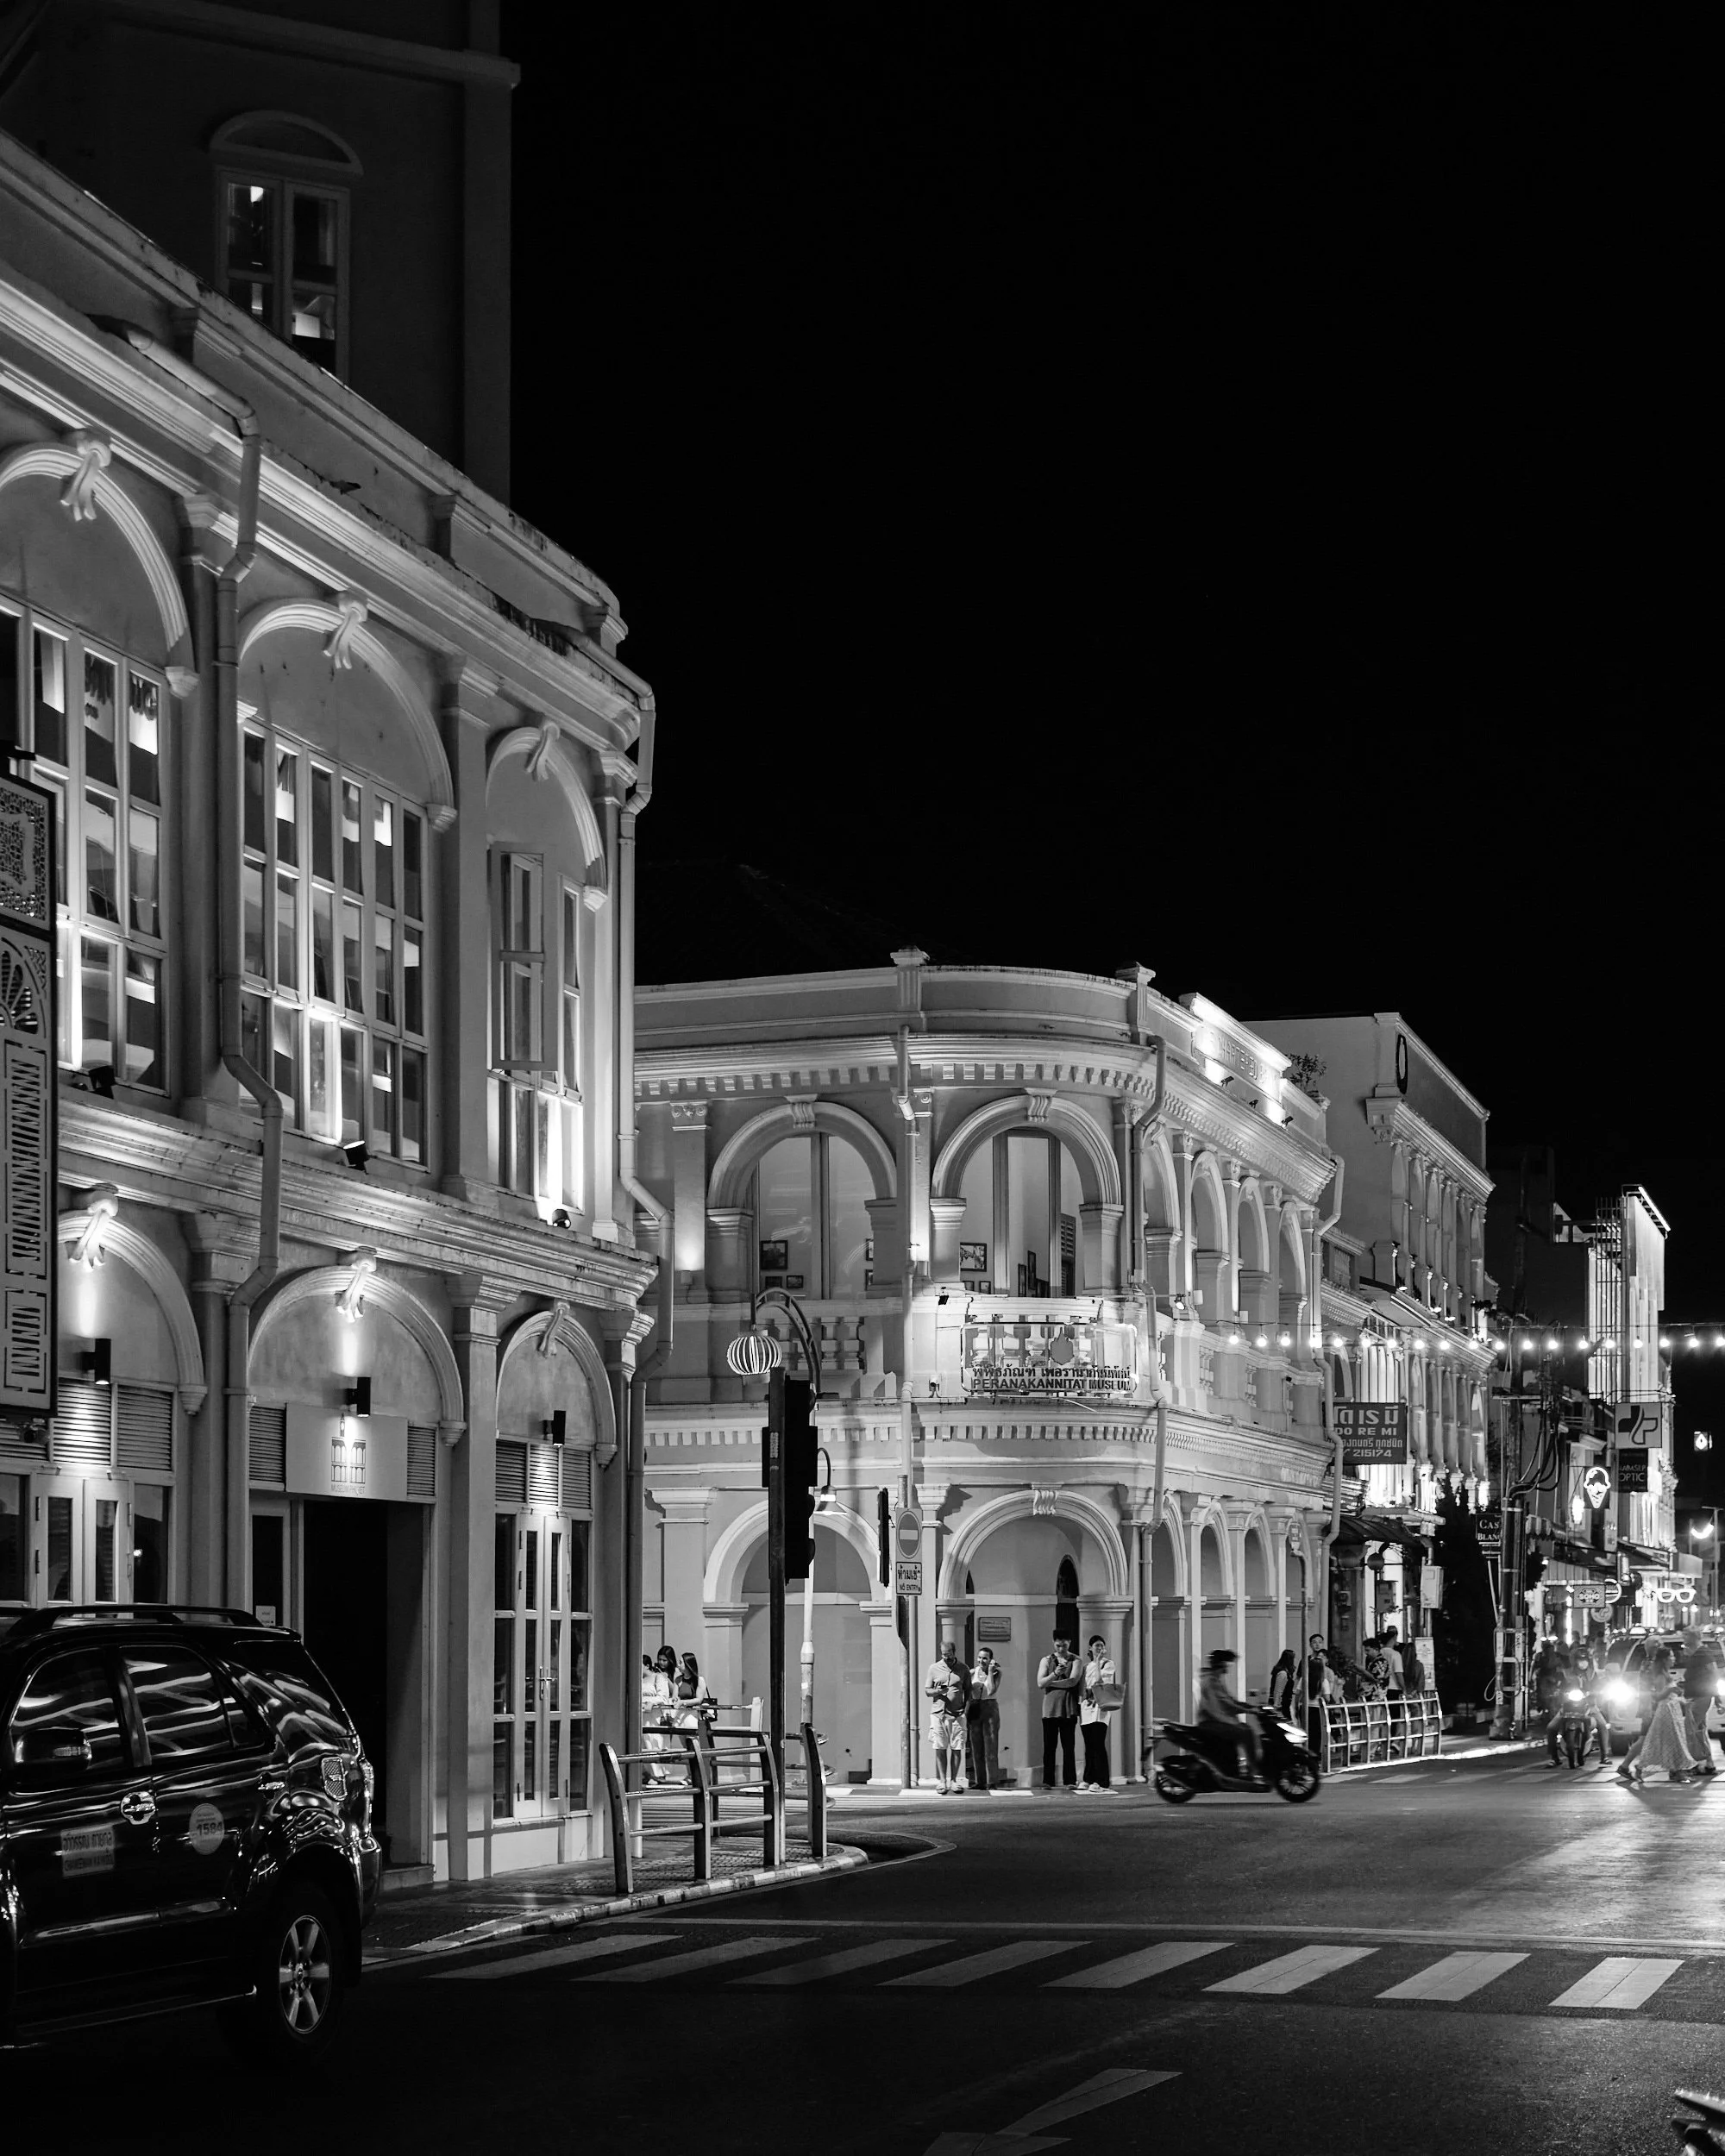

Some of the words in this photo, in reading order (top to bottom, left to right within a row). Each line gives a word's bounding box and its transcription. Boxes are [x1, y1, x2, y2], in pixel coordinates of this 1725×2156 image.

[973, 1378, 1086, 1389] PERANAKANNITAT
[1384, 1405, 1399, 1425] มี
[1334, 1427, 1353, 1436] DO
[1358, 1427, 1376, 1436] RE
[1381, 1427, 1397, 1436] MI
[1352, 1449, 1392, 1457] 215174
[1618, 1472, 1646, 1482] OPTIC
[197, 1821, 223, 1836] 1584
